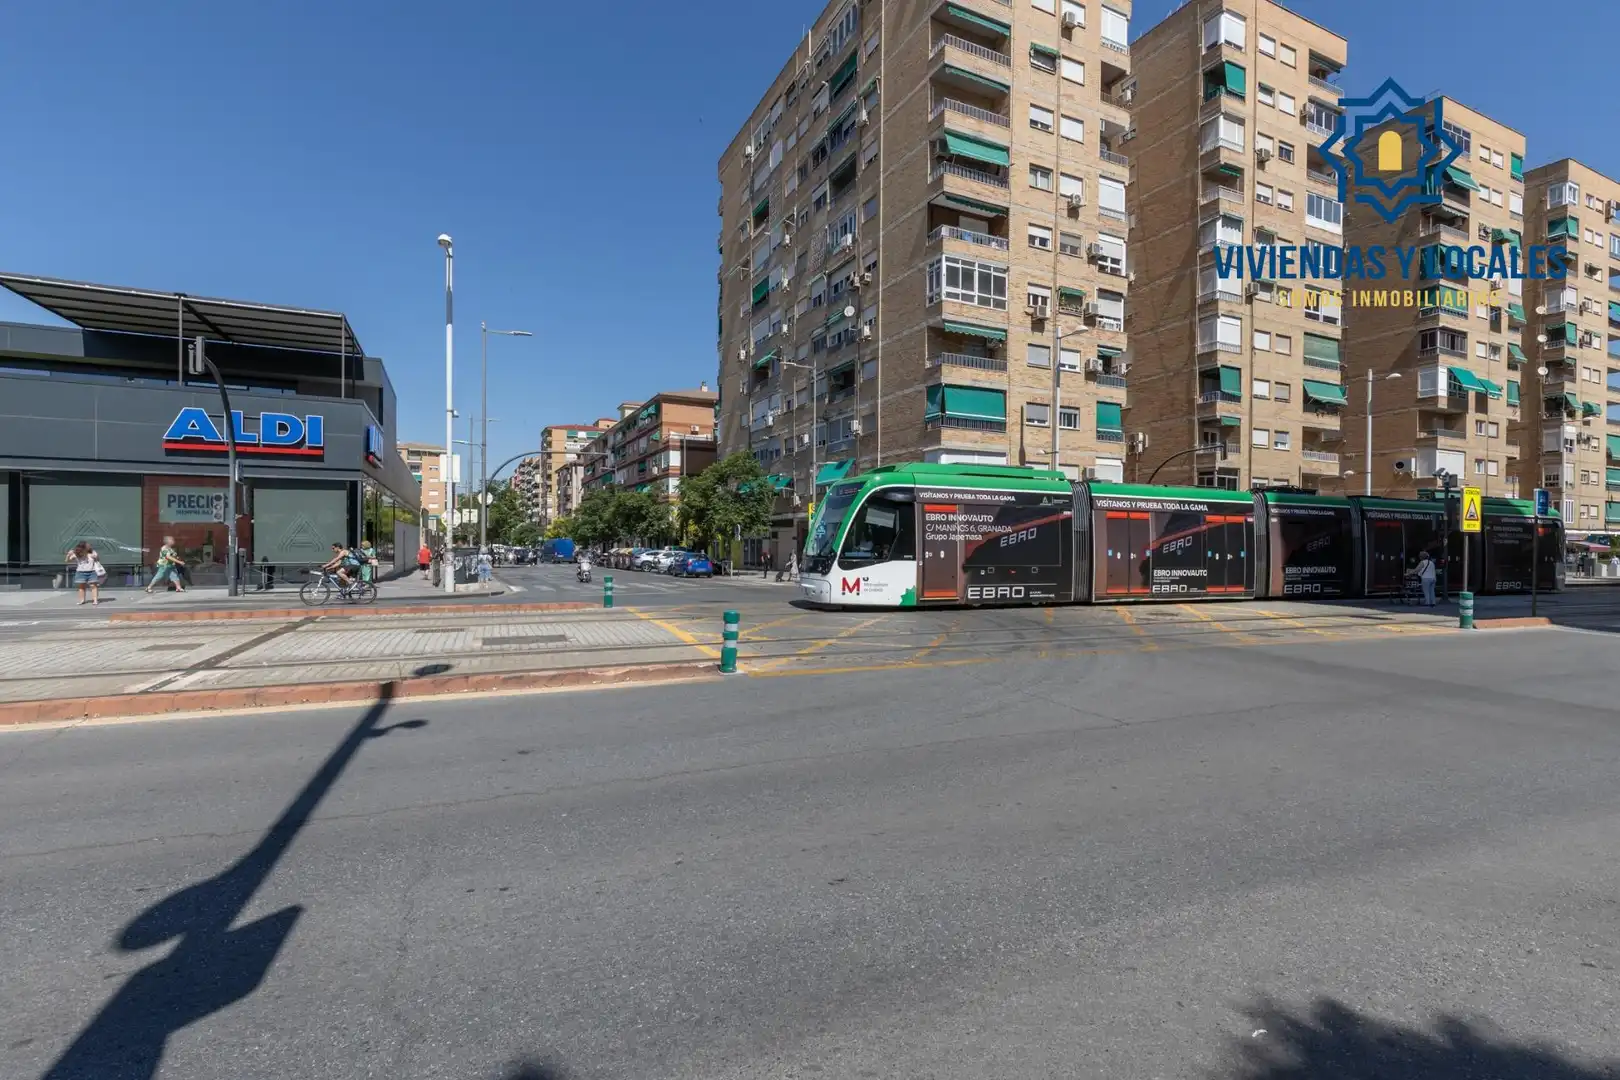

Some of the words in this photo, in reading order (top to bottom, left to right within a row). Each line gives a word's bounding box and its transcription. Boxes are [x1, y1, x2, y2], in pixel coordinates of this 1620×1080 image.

[163, 407, 324, 447] ALDI
[167, 494, 229, 508] PRECIS
[1137, 501, 1163, 509] PRUEBA
[925, 513, 947, 521] EBRO
[948, 514, 994, 523] INNOVAUTO
[925, 523, 934, 532] C/
[977, 525, 1013, 533] GRANADA
[925, 532, 948, 541] Grupo
[1000, 527, 1037, 548] EBRO
[1162, 535, 1192, 554] EBRO
[1171, 569, 1208, 577] INNOVAUTO
[841, 576, 861, 594] M
[1152, 584, 1187, 593] EBRO
[1284, 583, 1321, 594] EBRO
[967, 586, 1025, 599] EBRO
